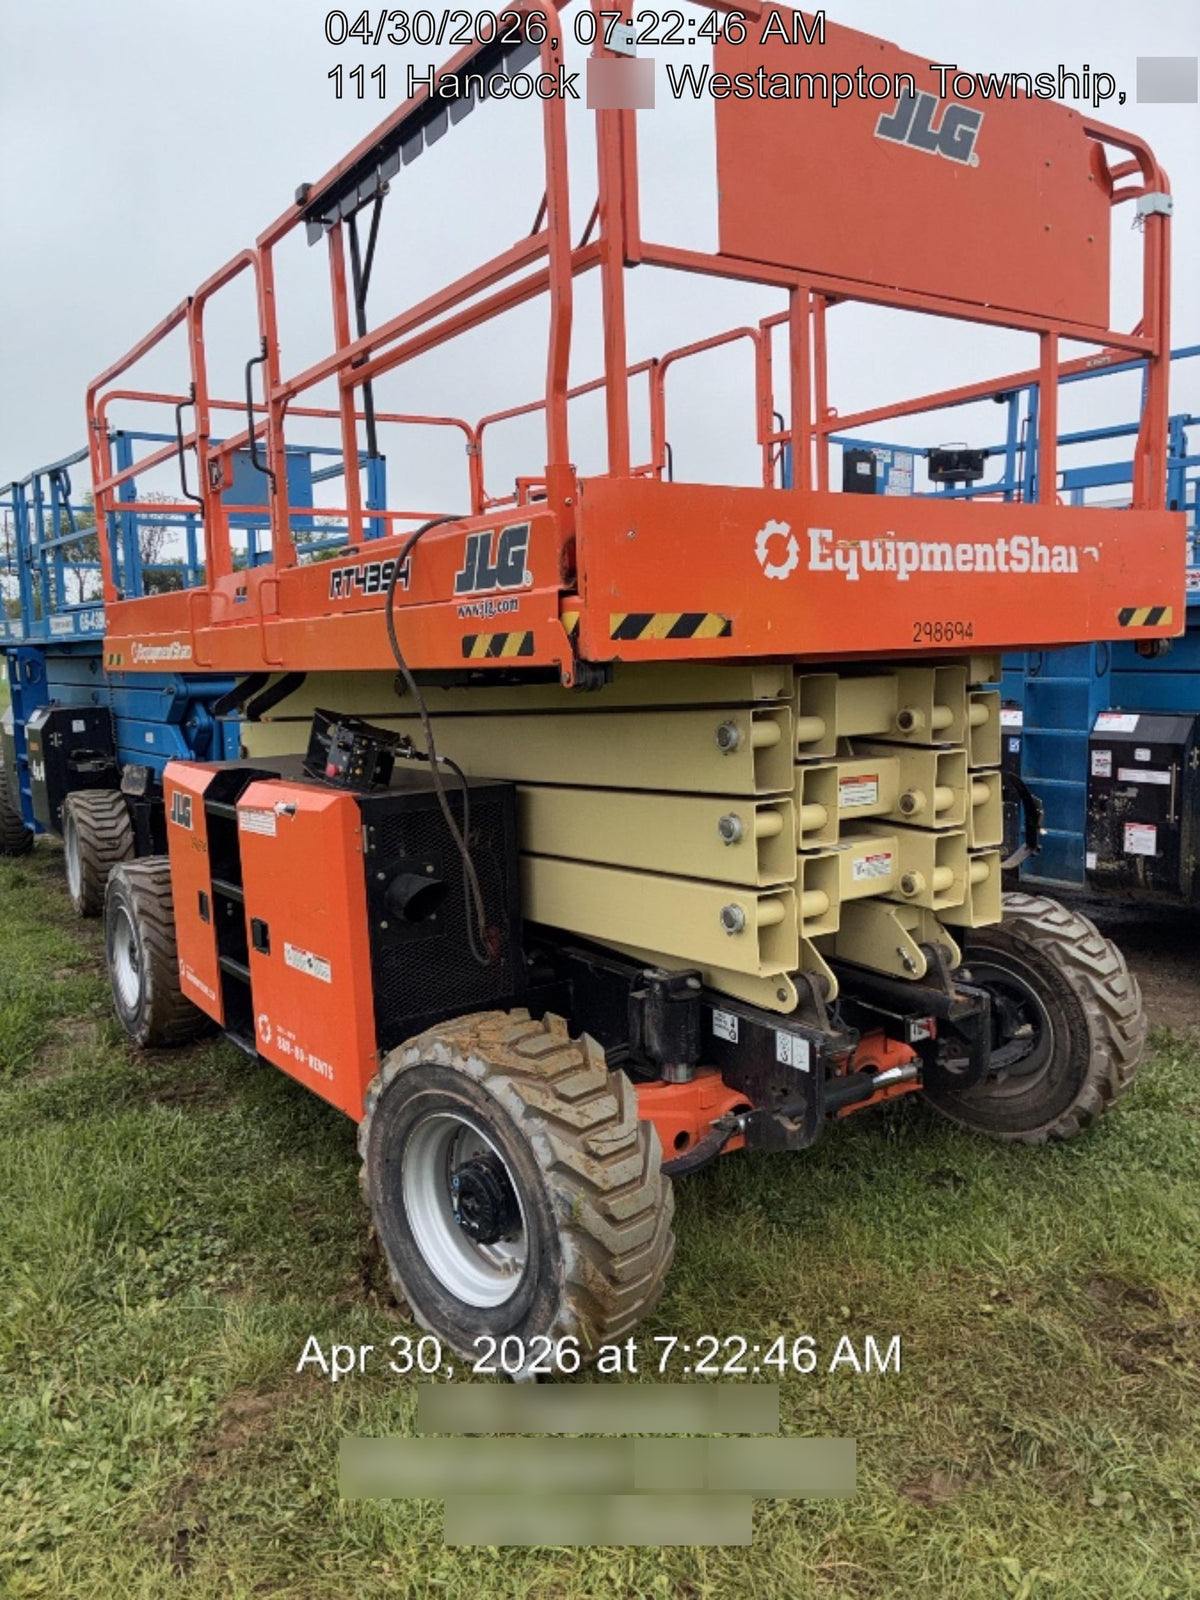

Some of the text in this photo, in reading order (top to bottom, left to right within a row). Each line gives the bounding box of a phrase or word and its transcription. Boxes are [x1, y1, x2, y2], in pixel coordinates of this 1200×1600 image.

[874, 85, 984, 167] JLG
[453, 521, 532, 596] JLG
[457, 598, 519, 619] www.jlg.com
[912, 621, 974, 643] 298694
[170, 790, 194, 831] JLG
